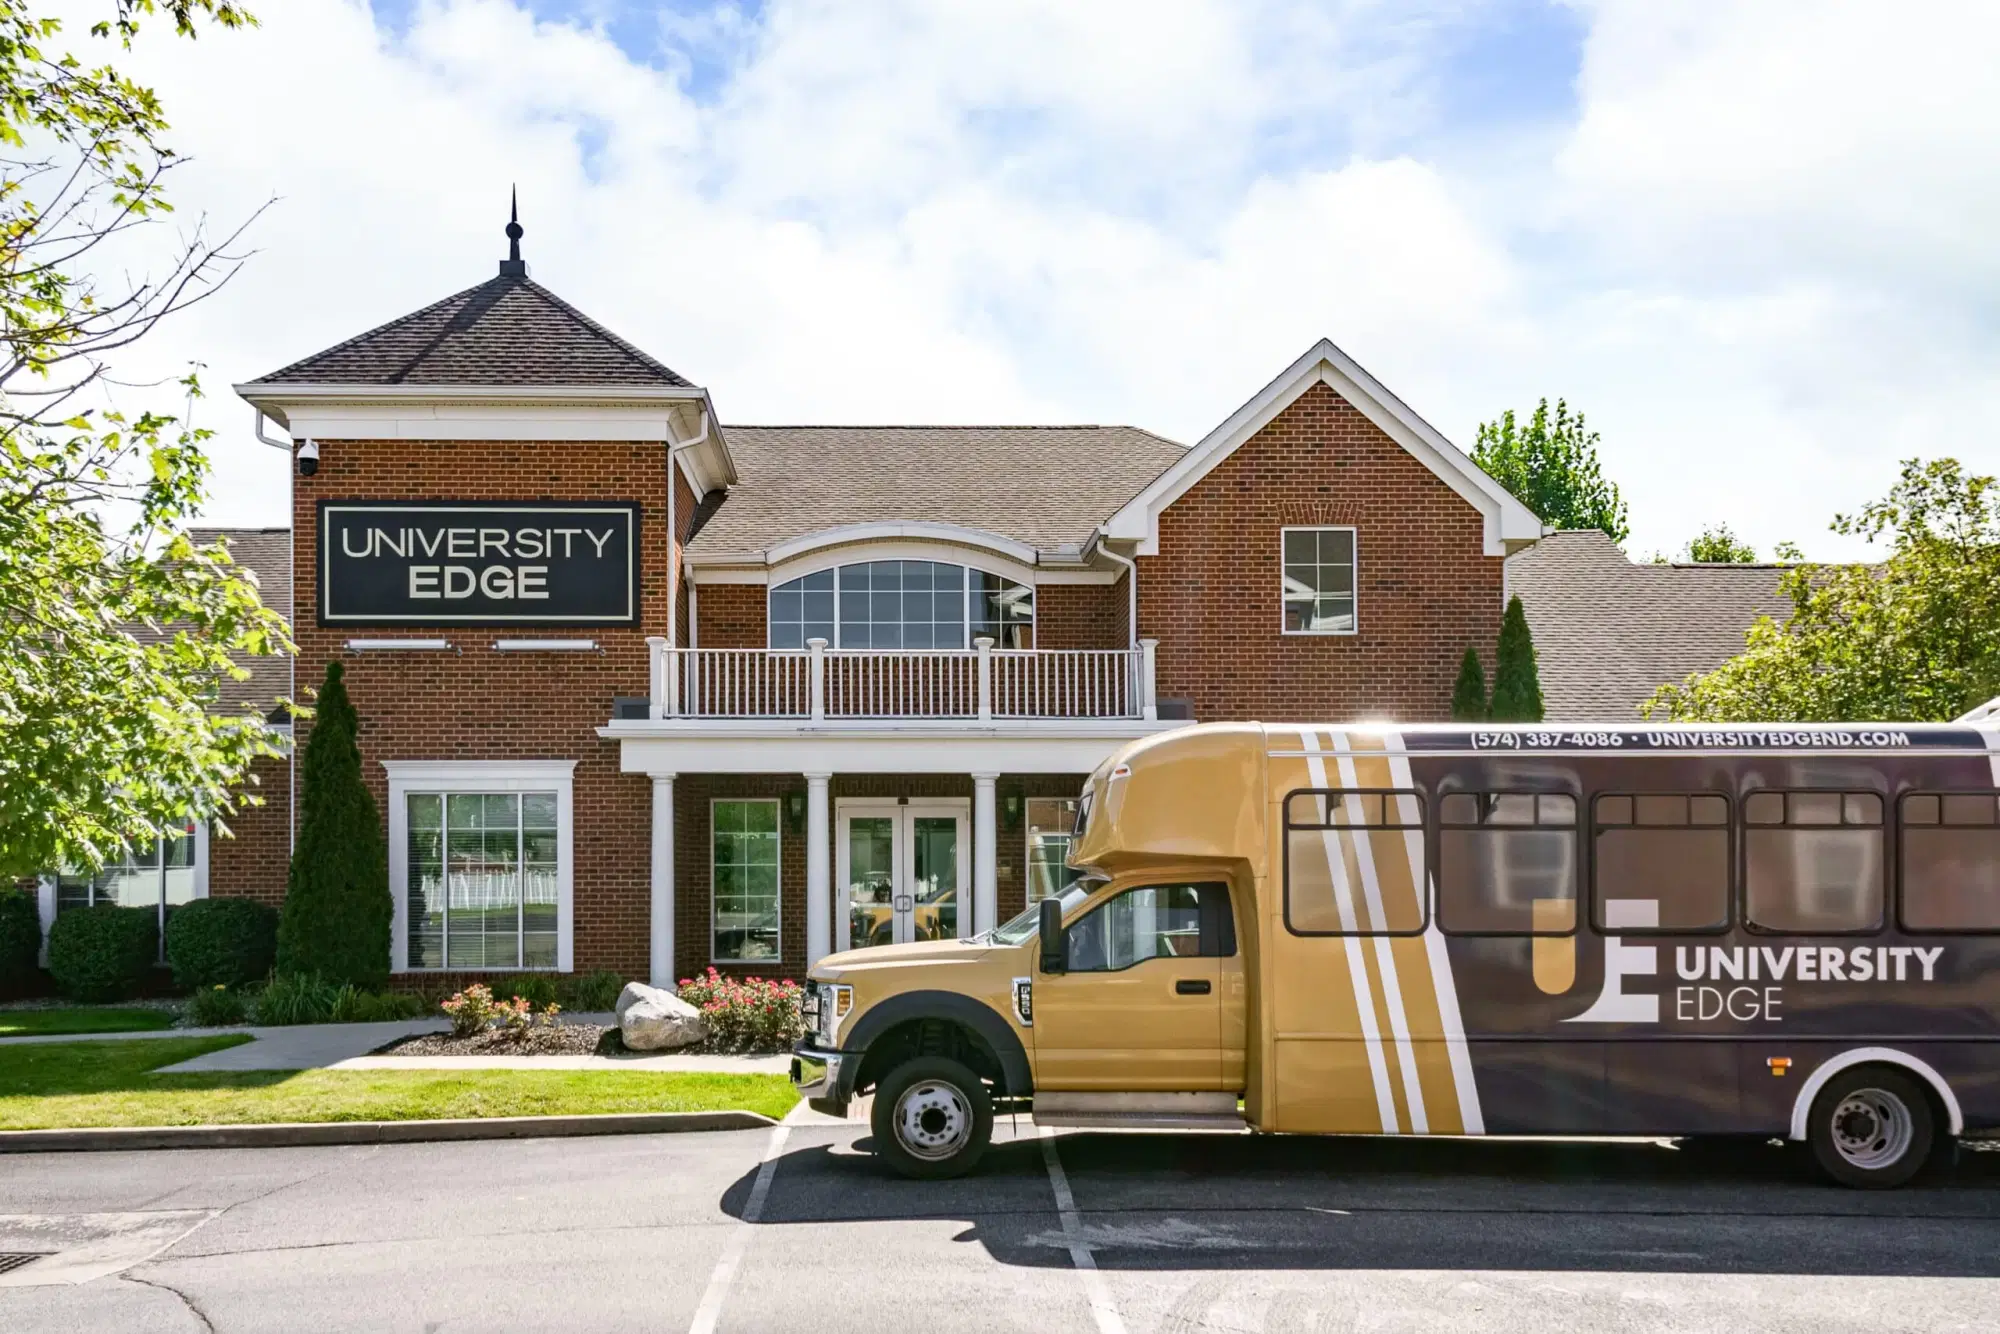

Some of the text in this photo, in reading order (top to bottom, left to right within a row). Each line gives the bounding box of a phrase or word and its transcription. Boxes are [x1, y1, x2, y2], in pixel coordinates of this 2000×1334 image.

[342, 528, 614, 558] UNIVERSITY
[409, 565, 549, 599] EDGE
[1471, 732, 1910, 749] (574) 387-4086 UNIVERSITYEDGEND.COM
[1676, 946, 1944, 981] UNIVERSITY
[1676, 986, 1783, 1021] EDGE
